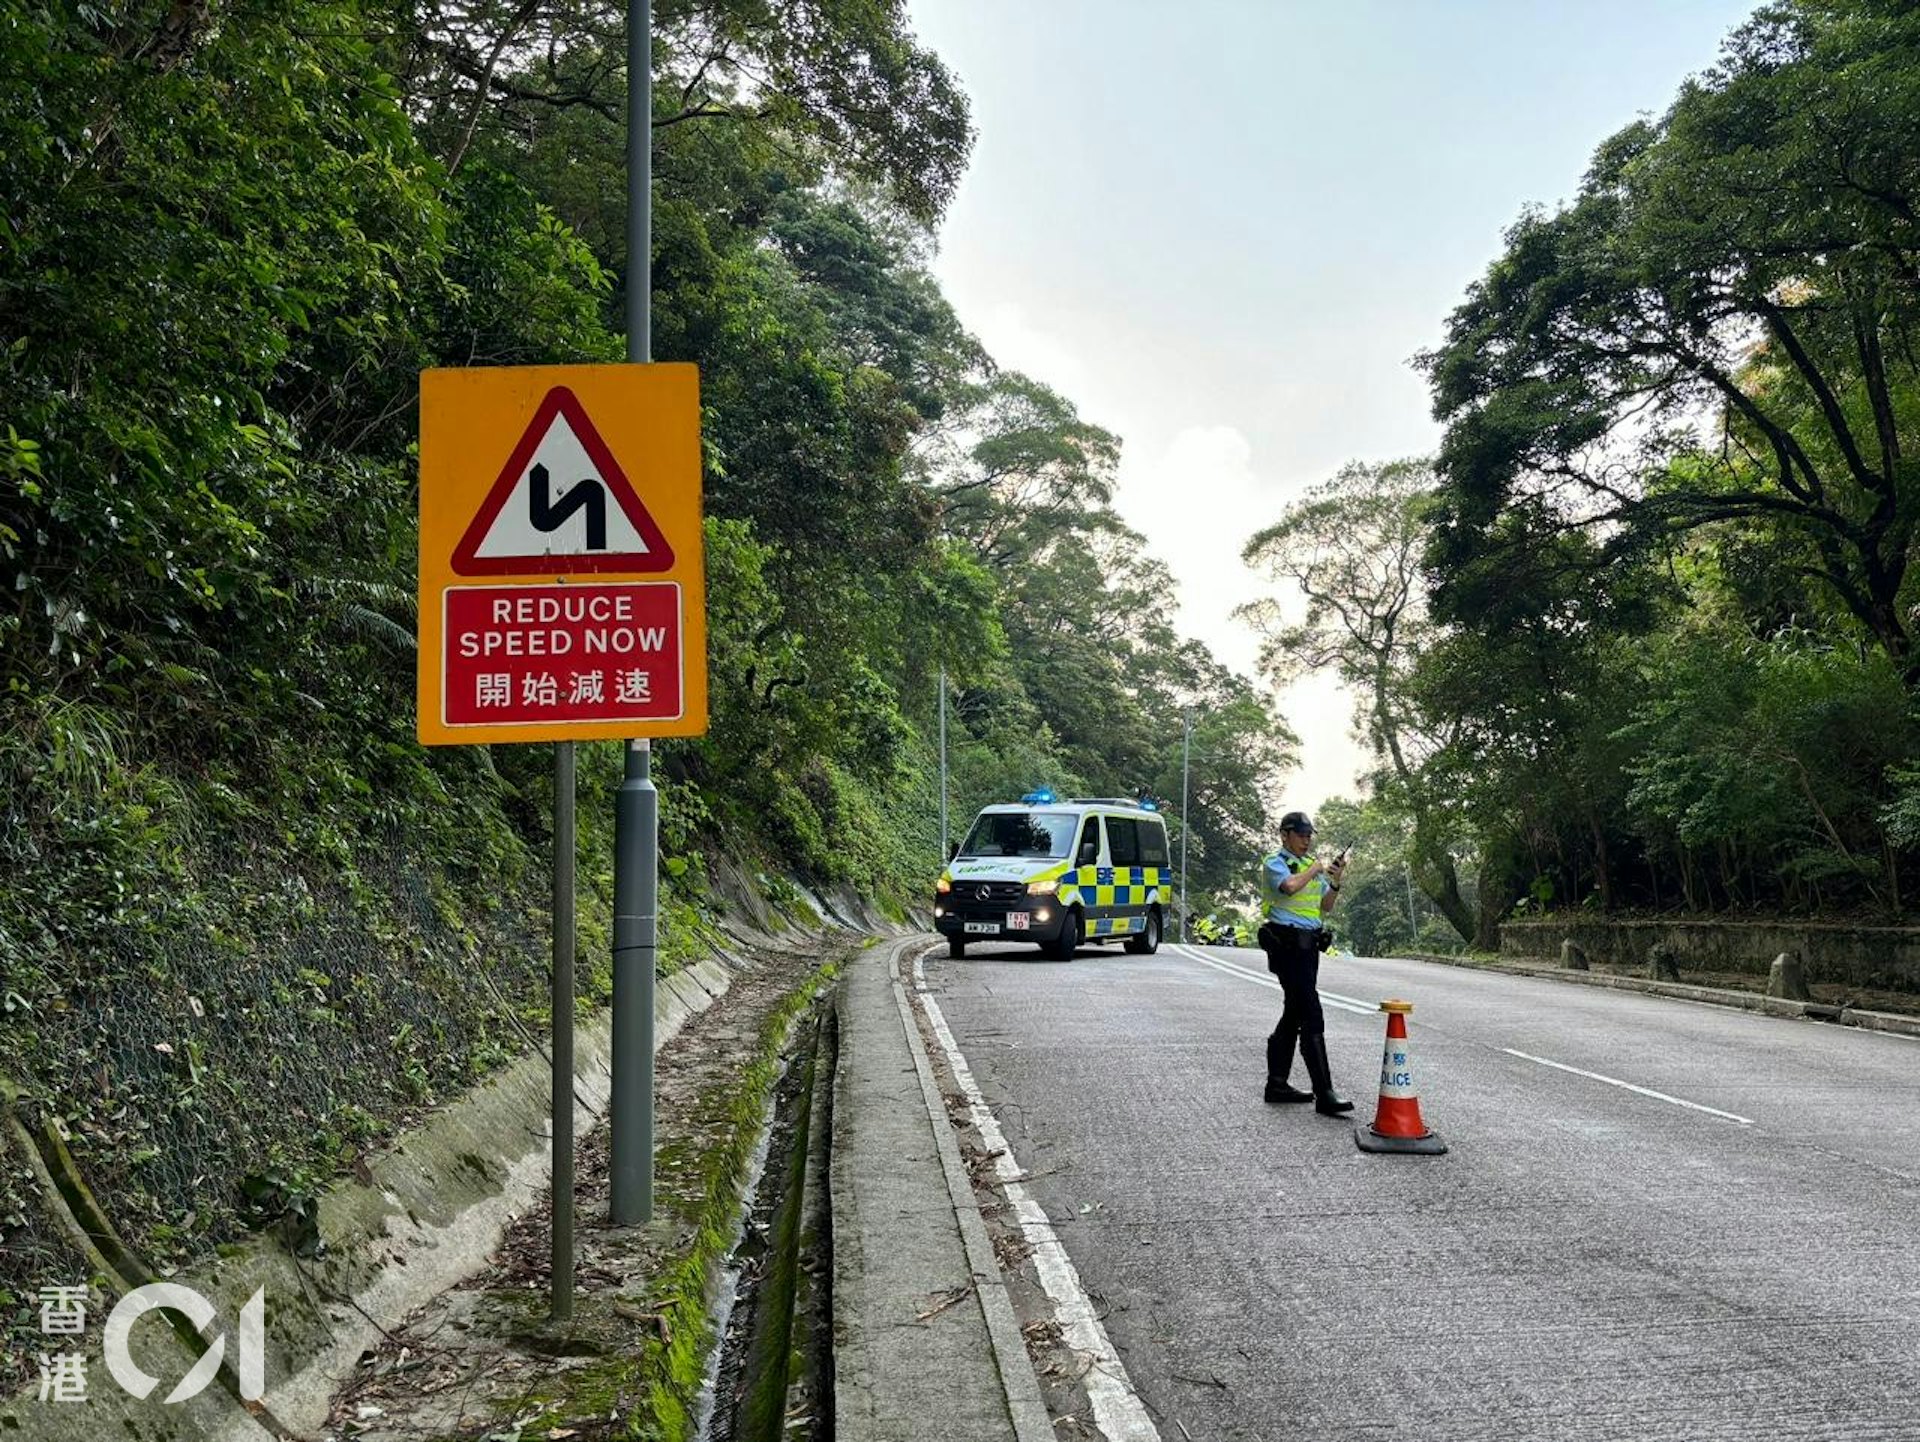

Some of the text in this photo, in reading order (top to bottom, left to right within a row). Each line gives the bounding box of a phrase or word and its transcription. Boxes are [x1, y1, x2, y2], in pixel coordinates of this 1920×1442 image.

[492, 596, 633, 624] REDUCE
[459, 627, 666, 657] SPEED NOW
[475, 668, 652, 708] 開始減速
[1381, 1071, 1411, 1086] OLICE
